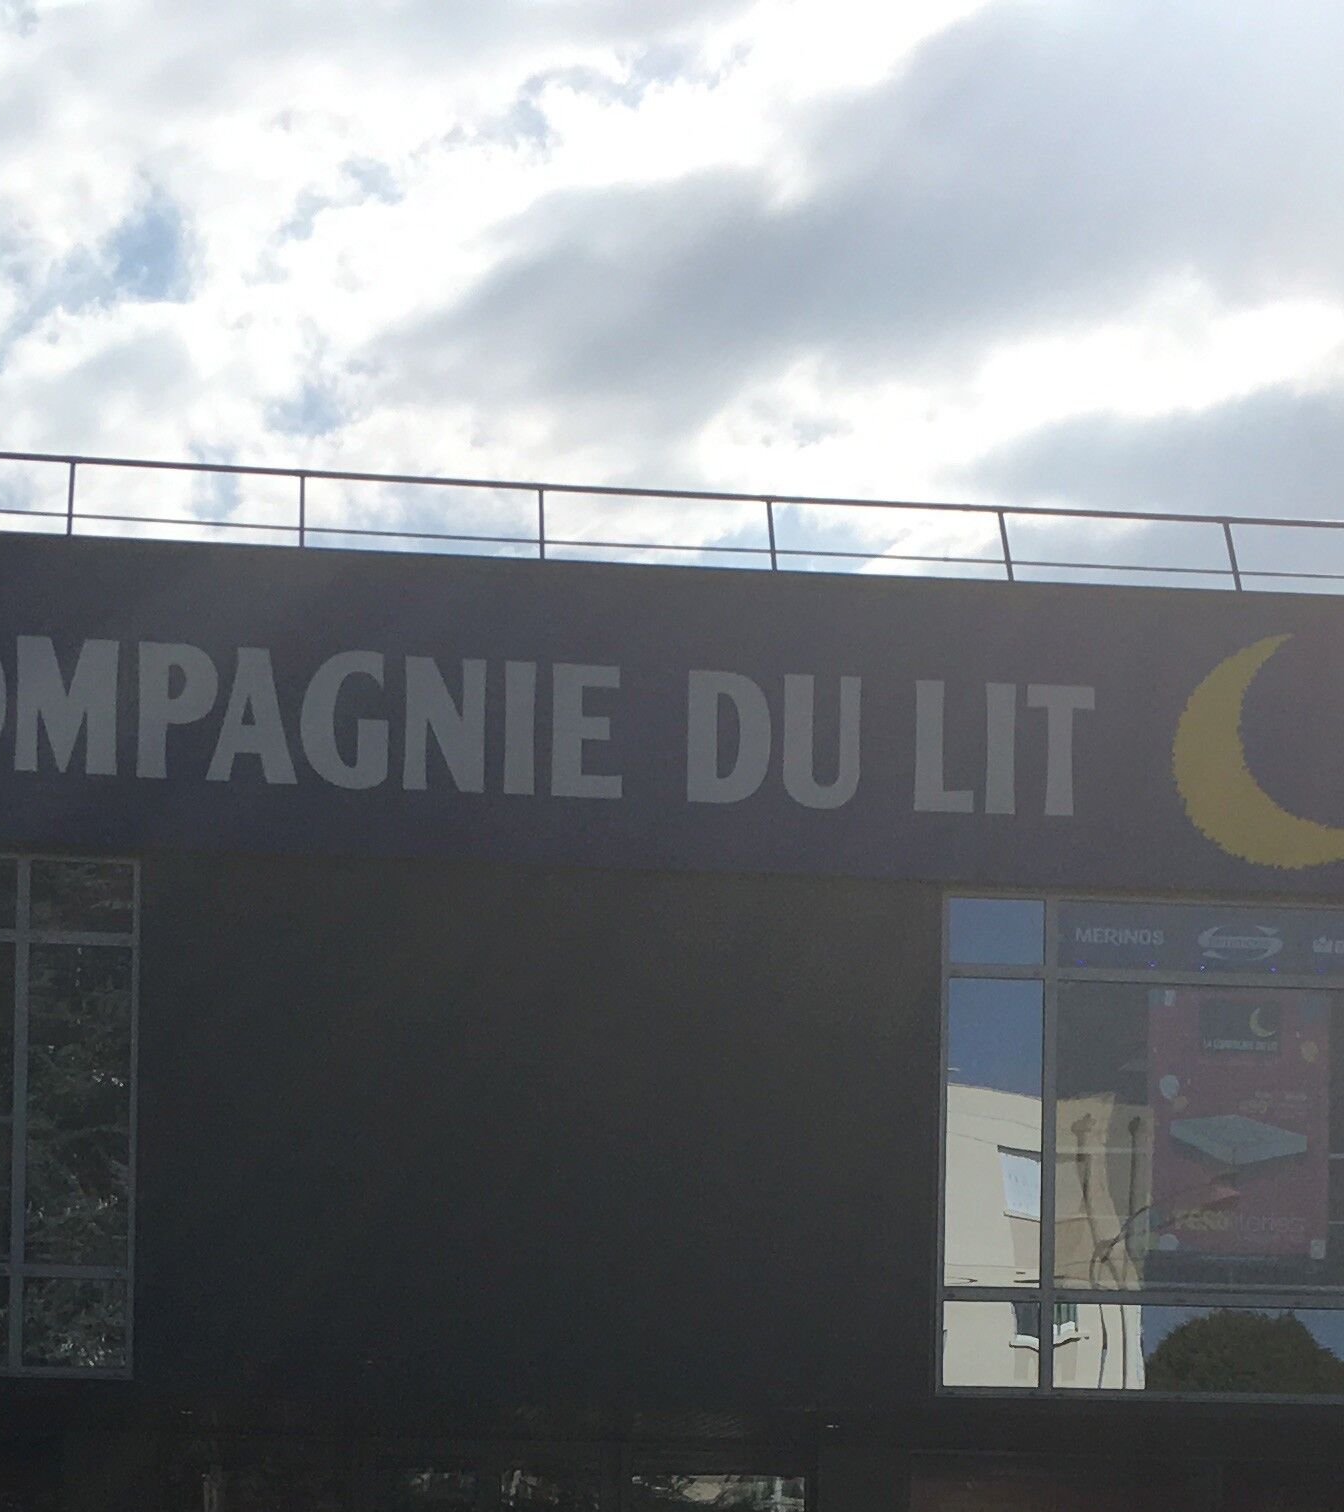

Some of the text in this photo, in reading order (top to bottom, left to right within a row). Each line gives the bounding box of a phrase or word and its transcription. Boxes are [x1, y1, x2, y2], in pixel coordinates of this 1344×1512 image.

[687, 669, 862, 809] DU
[913, 679, 1096, 817] LIT
[1074, 926, 1165, 947] MERINOS
